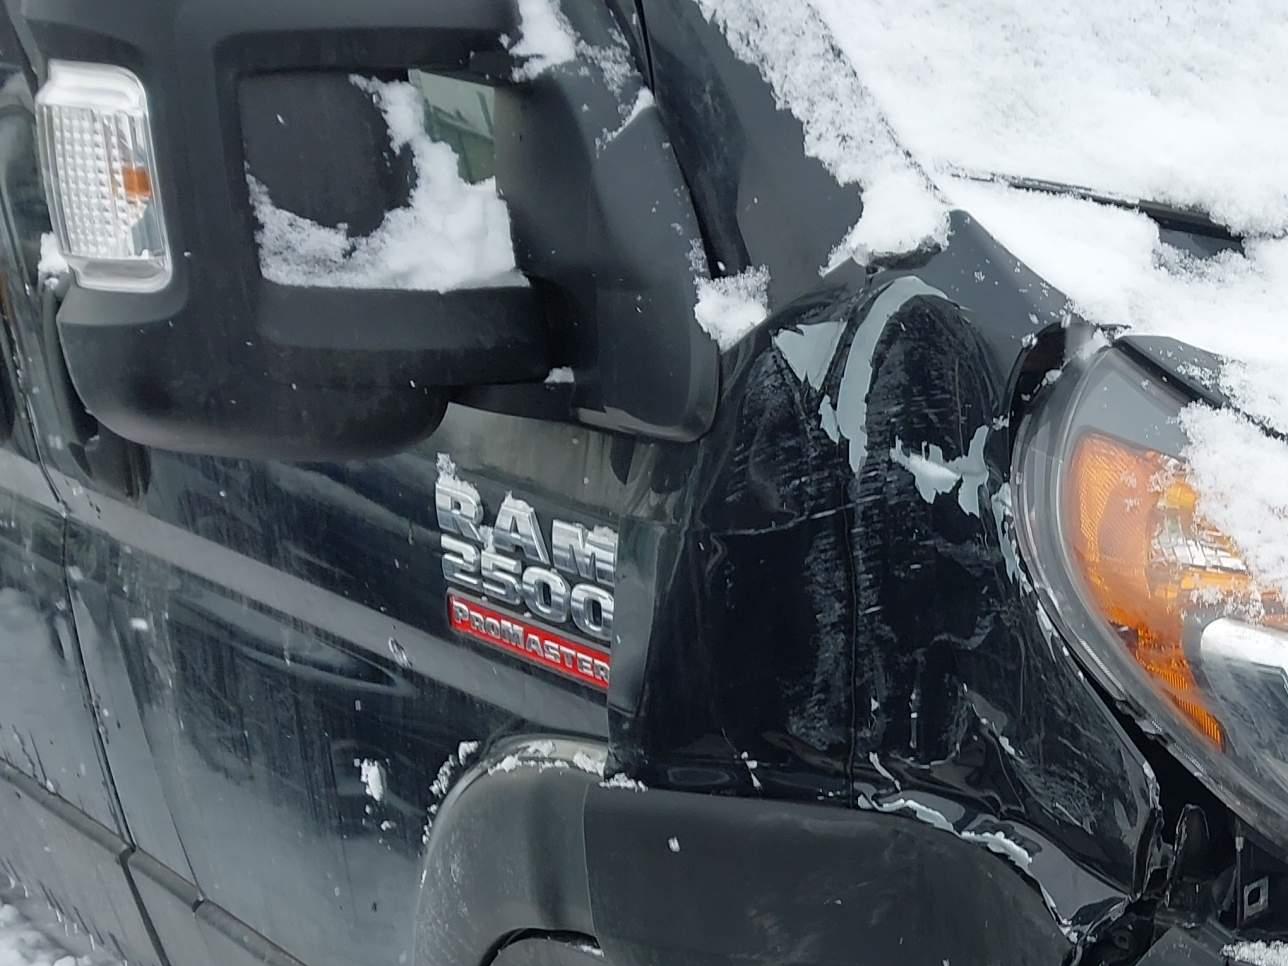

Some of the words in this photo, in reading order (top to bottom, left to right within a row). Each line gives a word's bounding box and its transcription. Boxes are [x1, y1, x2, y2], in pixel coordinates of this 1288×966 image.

[435, 479, 619, 586] RAM
[441, 533, 615, 641] 2500
[452, 599, 611, 683] PROMASTER
